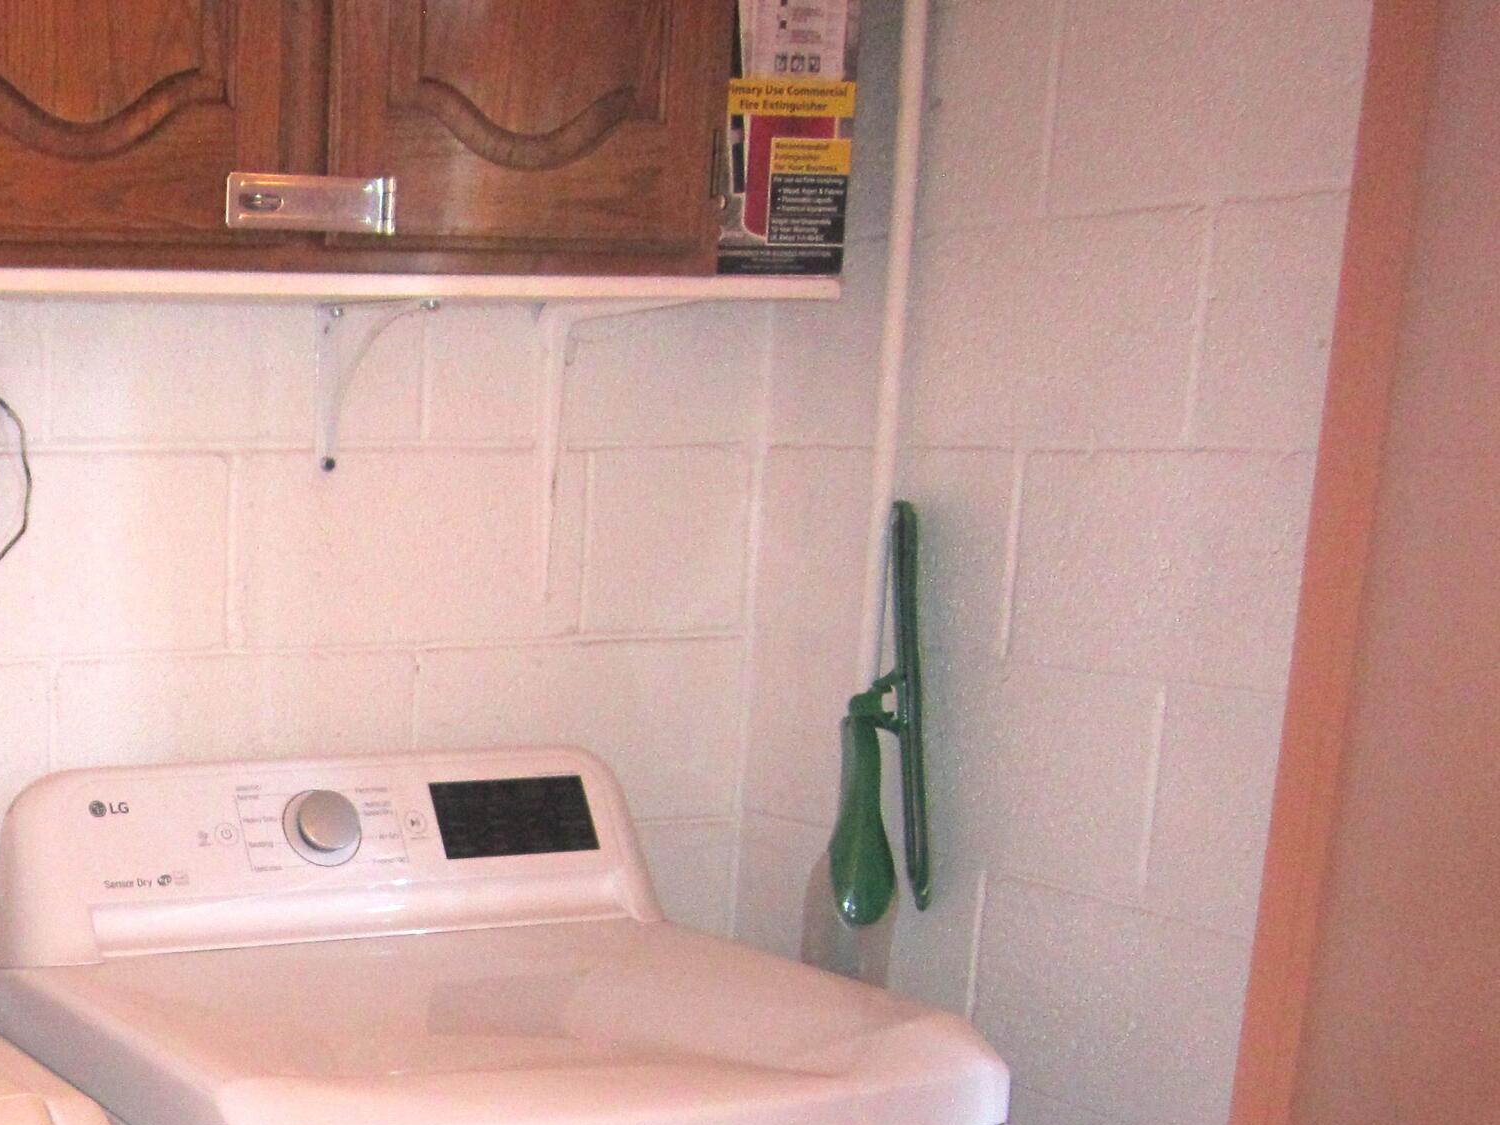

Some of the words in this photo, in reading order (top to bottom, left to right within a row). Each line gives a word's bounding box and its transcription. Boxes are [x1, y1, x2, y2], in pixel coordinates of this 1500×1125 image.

[765, 85, 785, 95] Use
[787, 85, 848, 97] Commercial
[740, 99, 759, 110] Fire
[762, 100, 828, 112] Extinguisher
[109, 801, 130, 815] LG
[103, 879, 135, 889] Sensor
[136, 877, 153, 889] Dry
